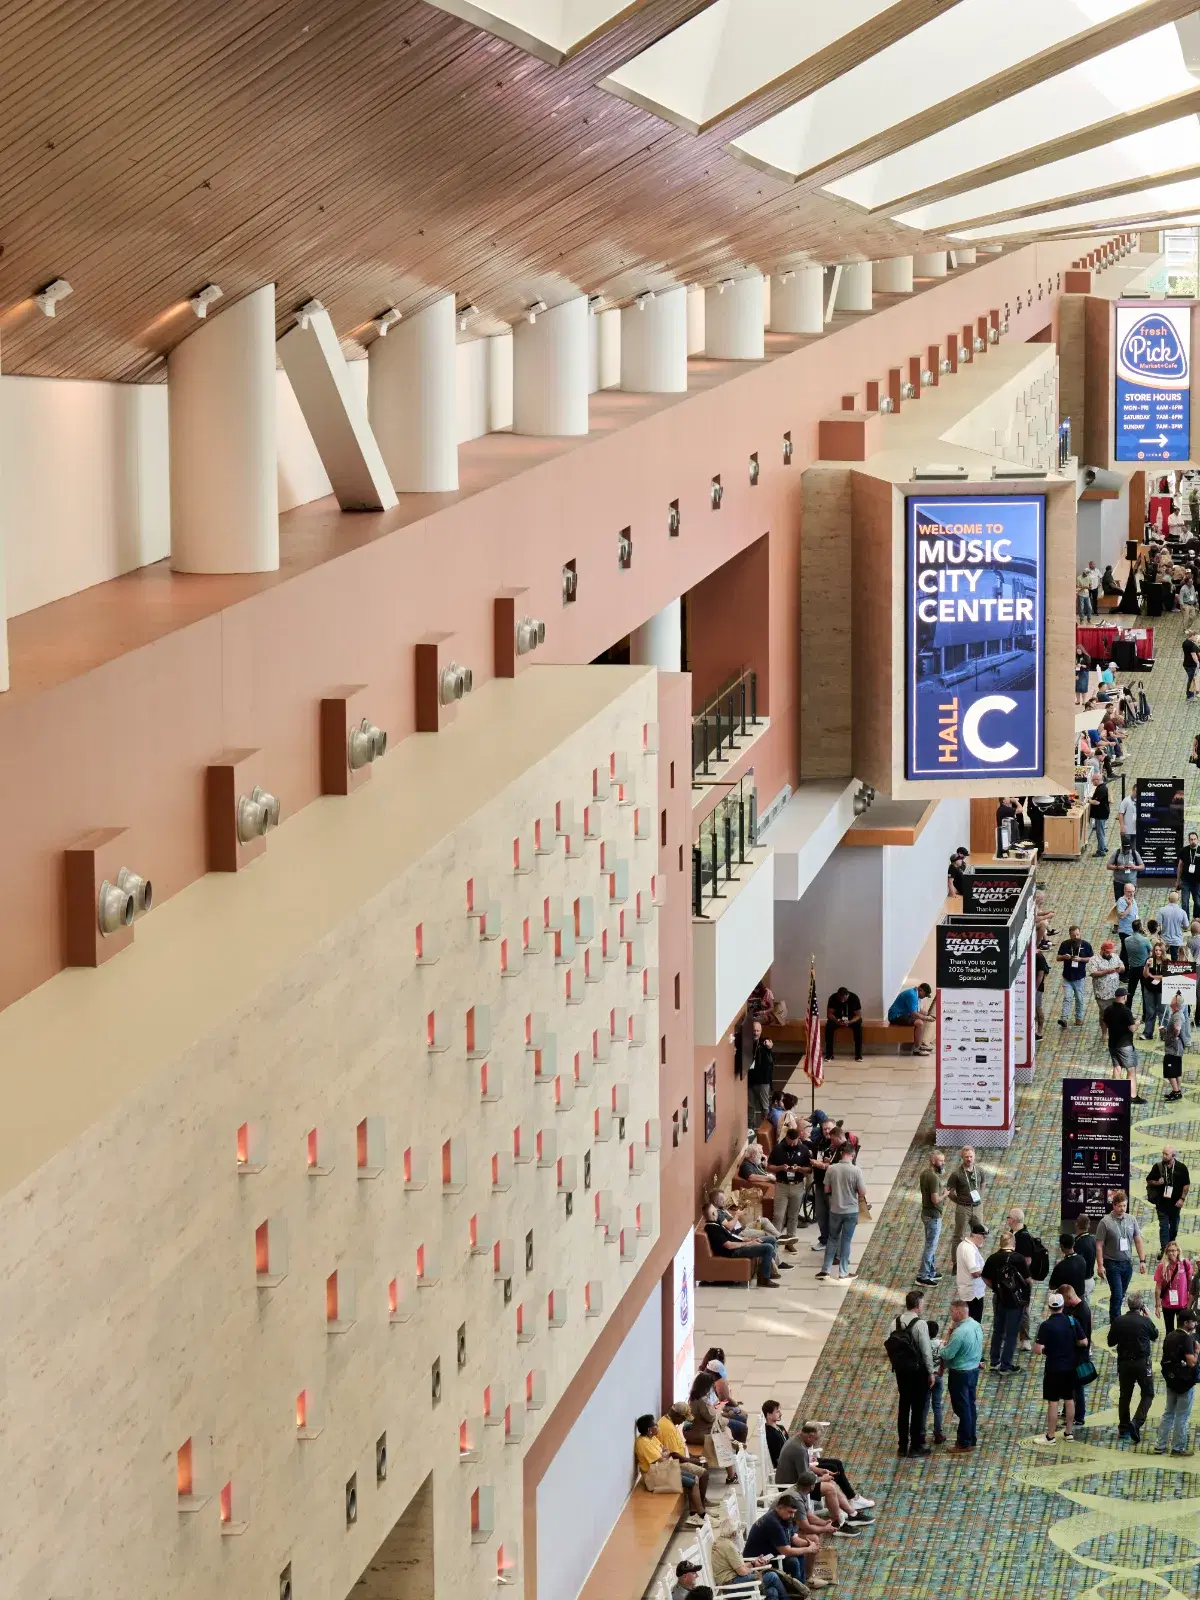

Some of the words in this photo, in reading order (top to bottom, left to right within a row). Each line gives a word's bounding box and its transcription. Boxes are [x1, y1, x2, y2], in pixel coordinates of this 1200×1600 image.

[1140, 326, 1167, 335] fresh
[1128, 336, 1179, 363] Pick
[1125, 393, 1151, 401] STORE
[1153, 393, 1182, 401] HOURS
[918, 524, 982, 535] WELCOME
[986, 524, 1004, 534] TO
[919, 540, 1012, 564] MUSIC
[918, 569, 984, 593] CITY
[918, 598, 1034, 623] CENTER
[938, 697, 958, 763] HALL
[962, 695, 1019, 763] C
